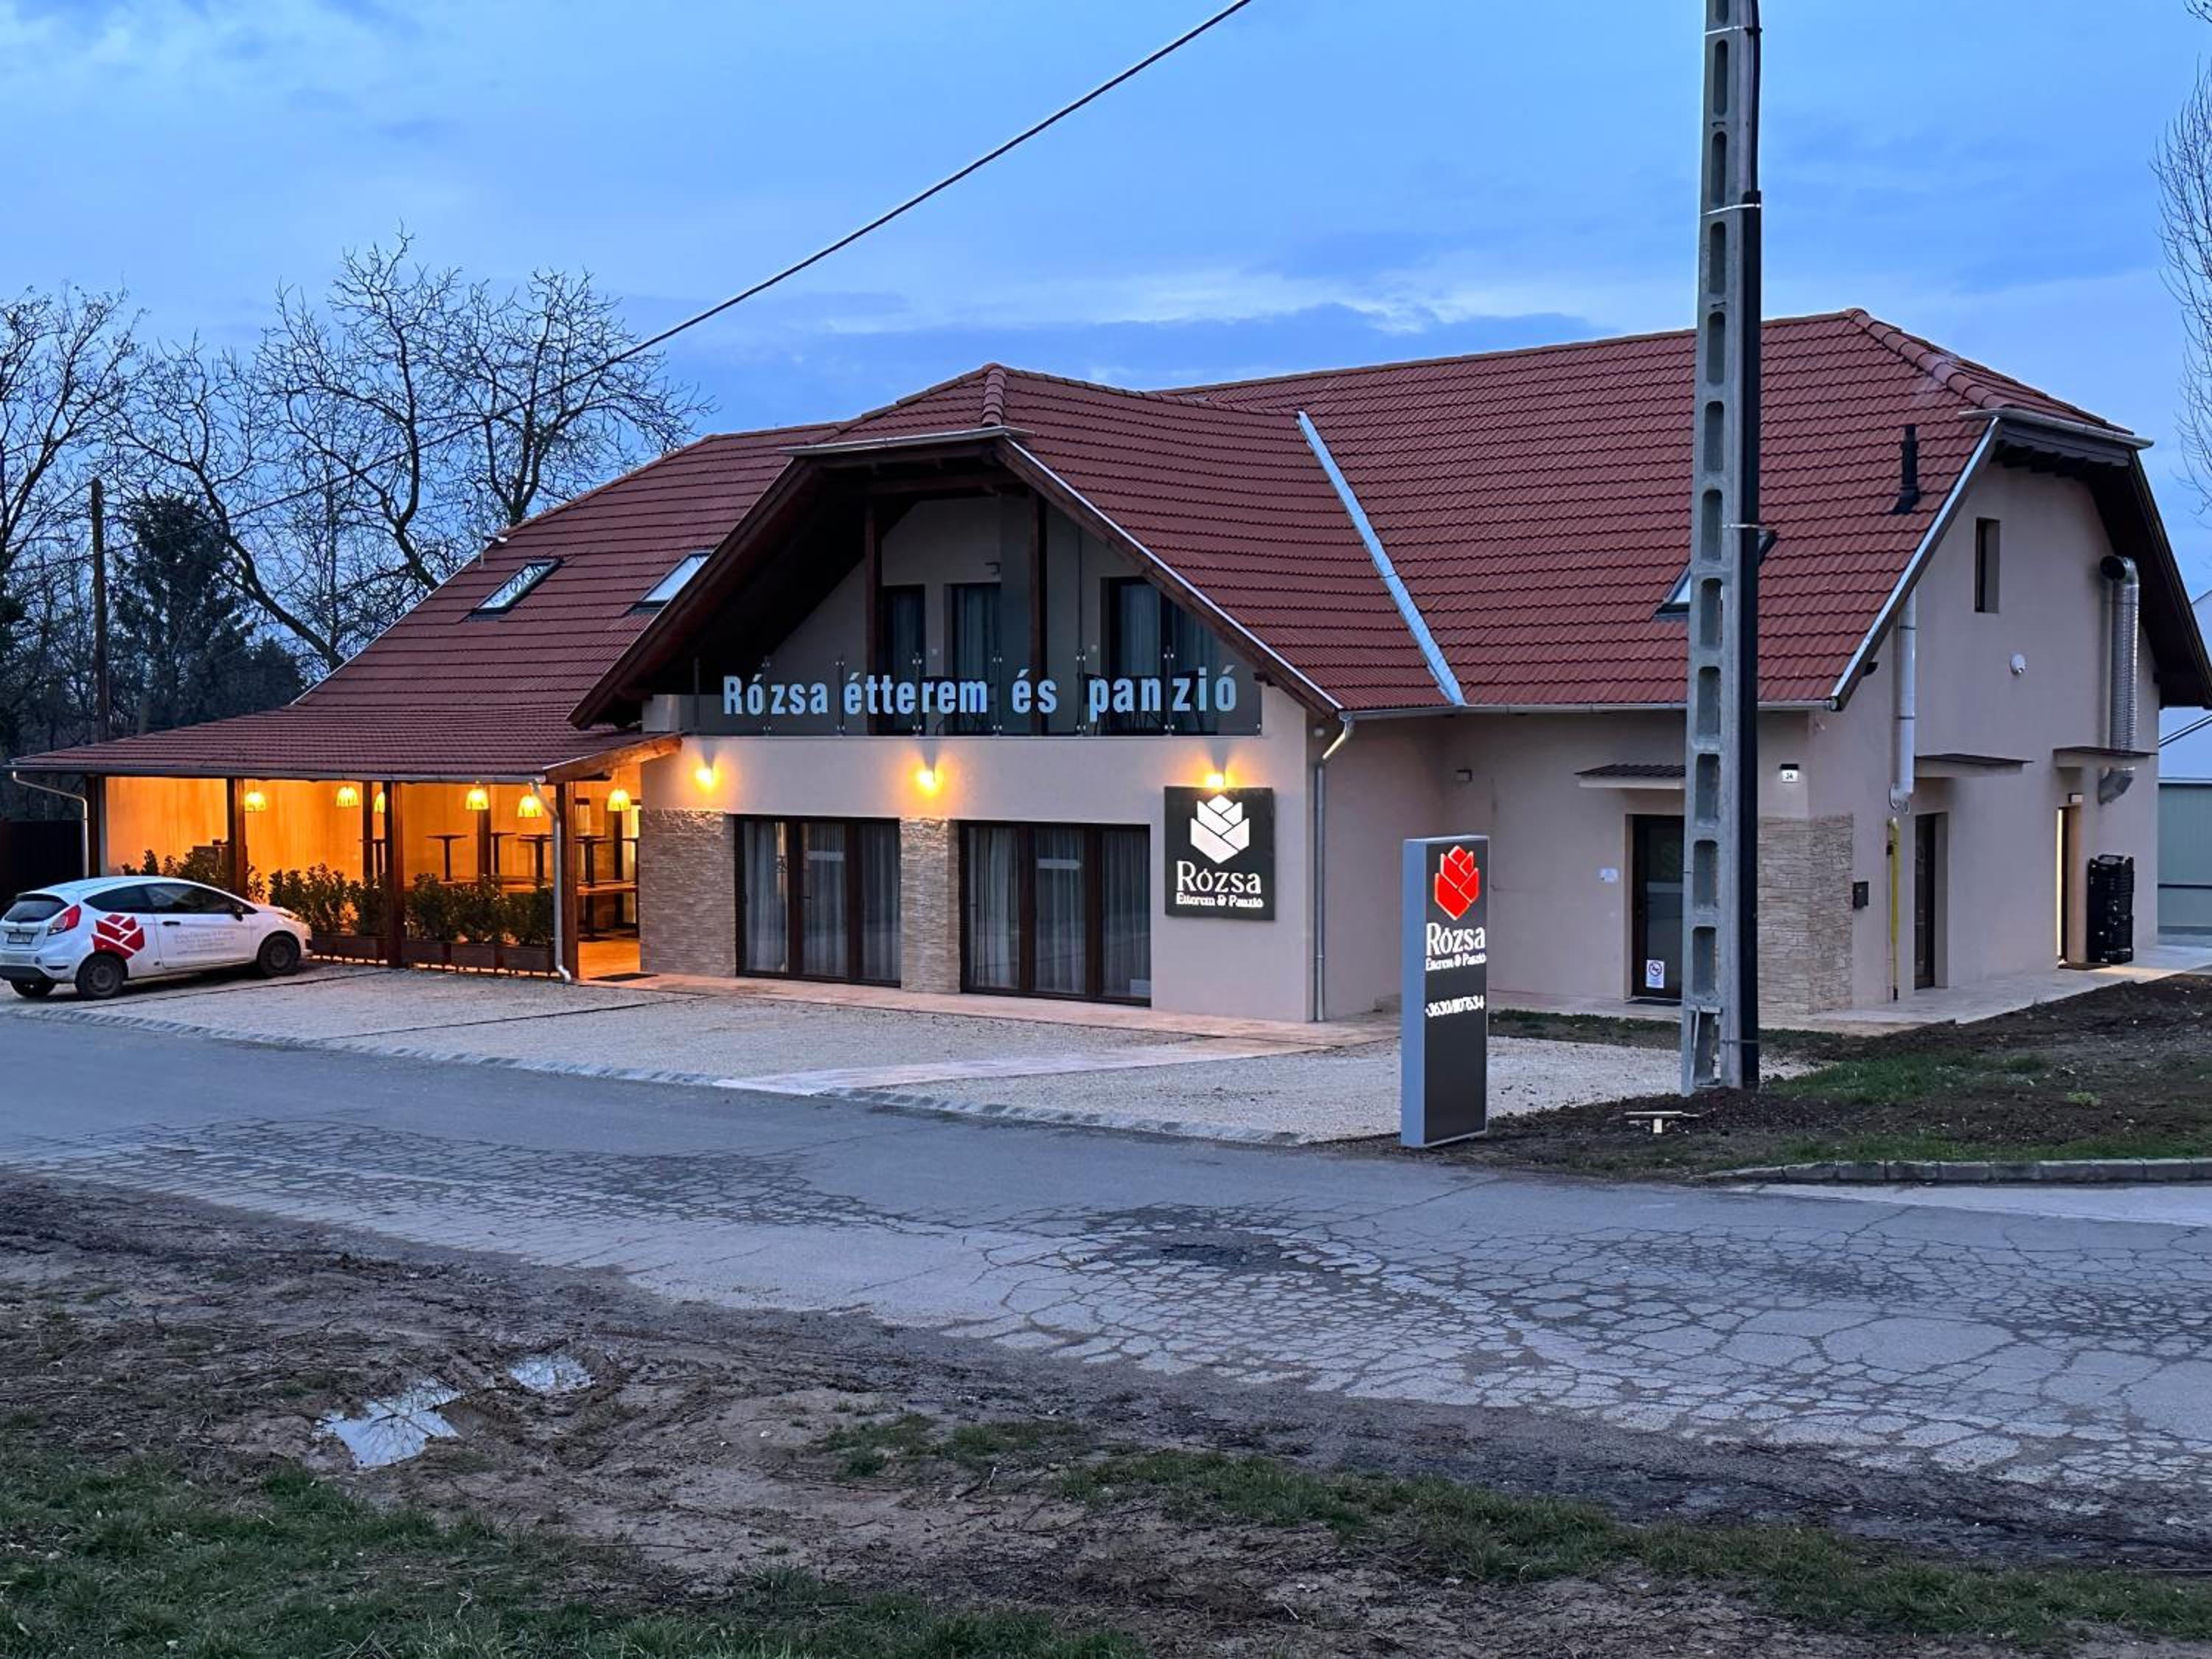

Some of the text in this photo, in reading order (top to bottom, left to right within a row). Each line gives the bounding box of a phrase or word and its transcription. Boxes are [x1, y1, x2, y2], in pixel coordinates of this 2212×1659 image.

[723, 665, 1237, 723] Rózsa étterem és panzió
[1177, 860, 1262, 894] Rózsa
[1427, 922, 1486, 956] Rózsa
